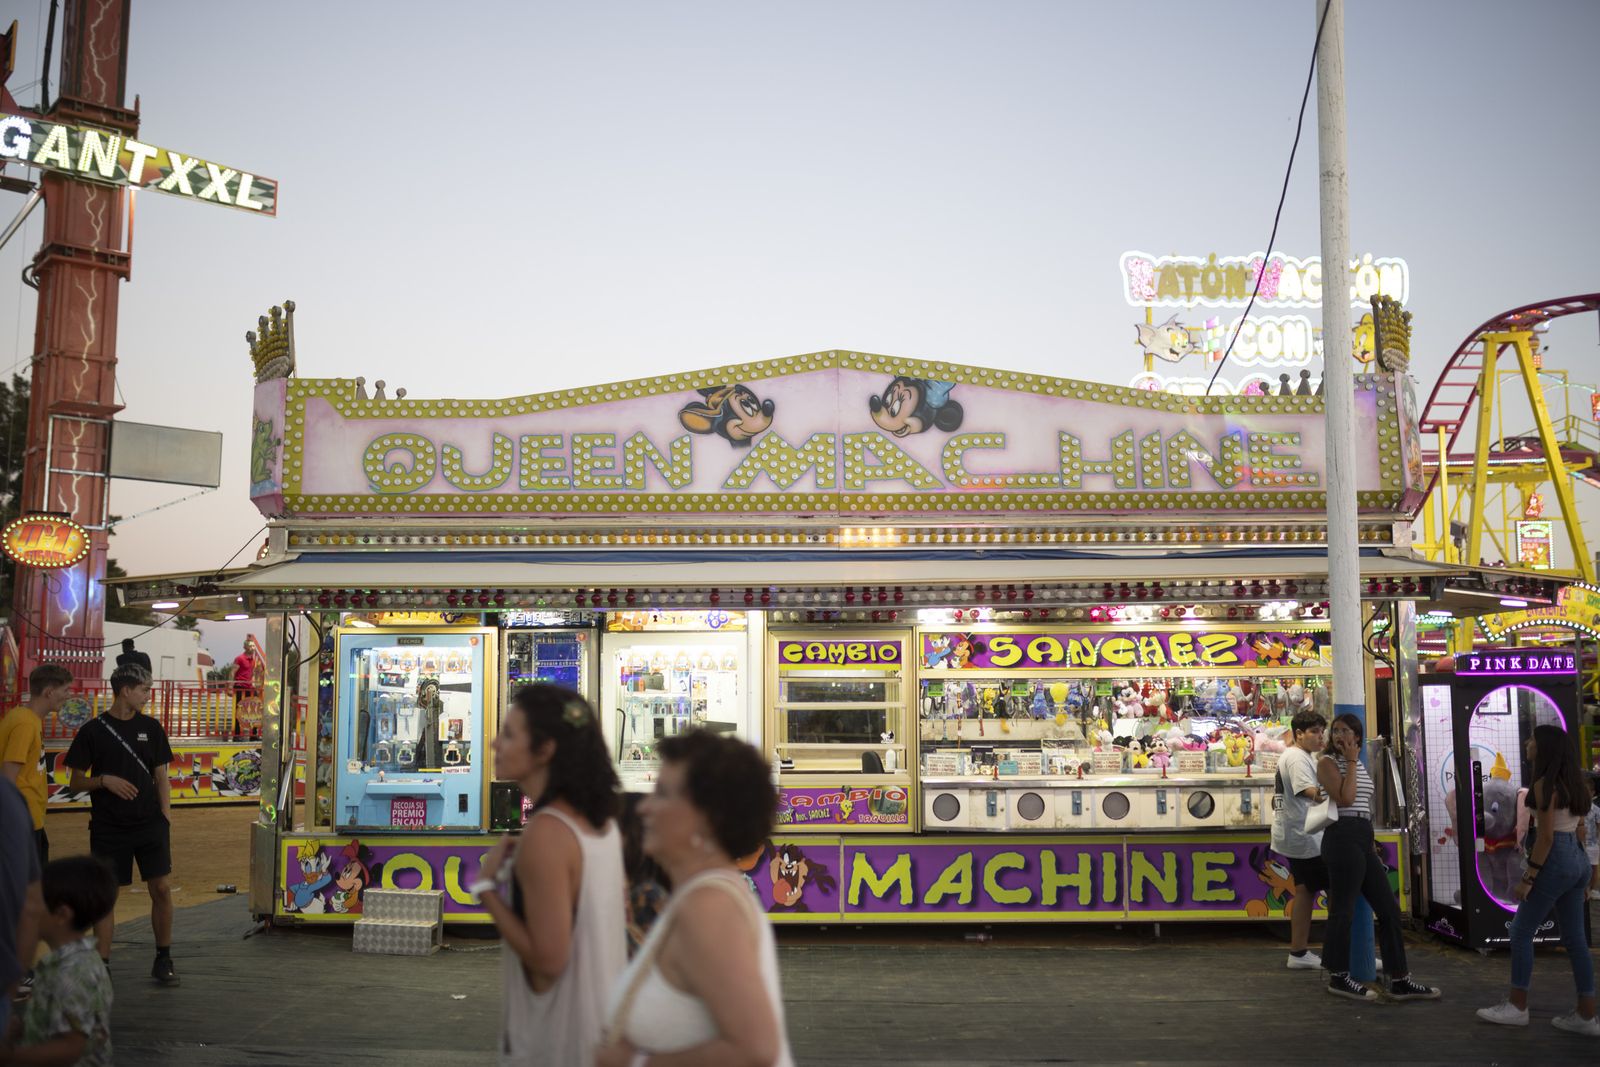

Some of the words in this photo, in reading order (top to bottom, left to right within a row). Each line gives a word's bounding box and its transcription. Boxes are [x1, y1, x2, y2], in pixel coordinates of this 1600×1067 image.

[1233, 319, 1307, 359] CON
[363, 431, 694, 495] QUEEN
[721, 431, 1320, 491] MACHINE
[783, 642, 898, 665] CAMBIO
[988, 633, 1238, 669] SANCHEZ
[1470, 657, 1522, 670] PINK
[1528, 657, 1575, 670] DATE
[392, 809, 425, 818] PREMIO
[393, 801, 415, 809] RECOJA
[415, 801, 425, 809] SU
[392, 819, 403, 827] EN
[403, 819, 425, 827] CAJA
[858, 813, 907, 823] TAQUILLA
[846, 849, 1236, 906] MACHINE
